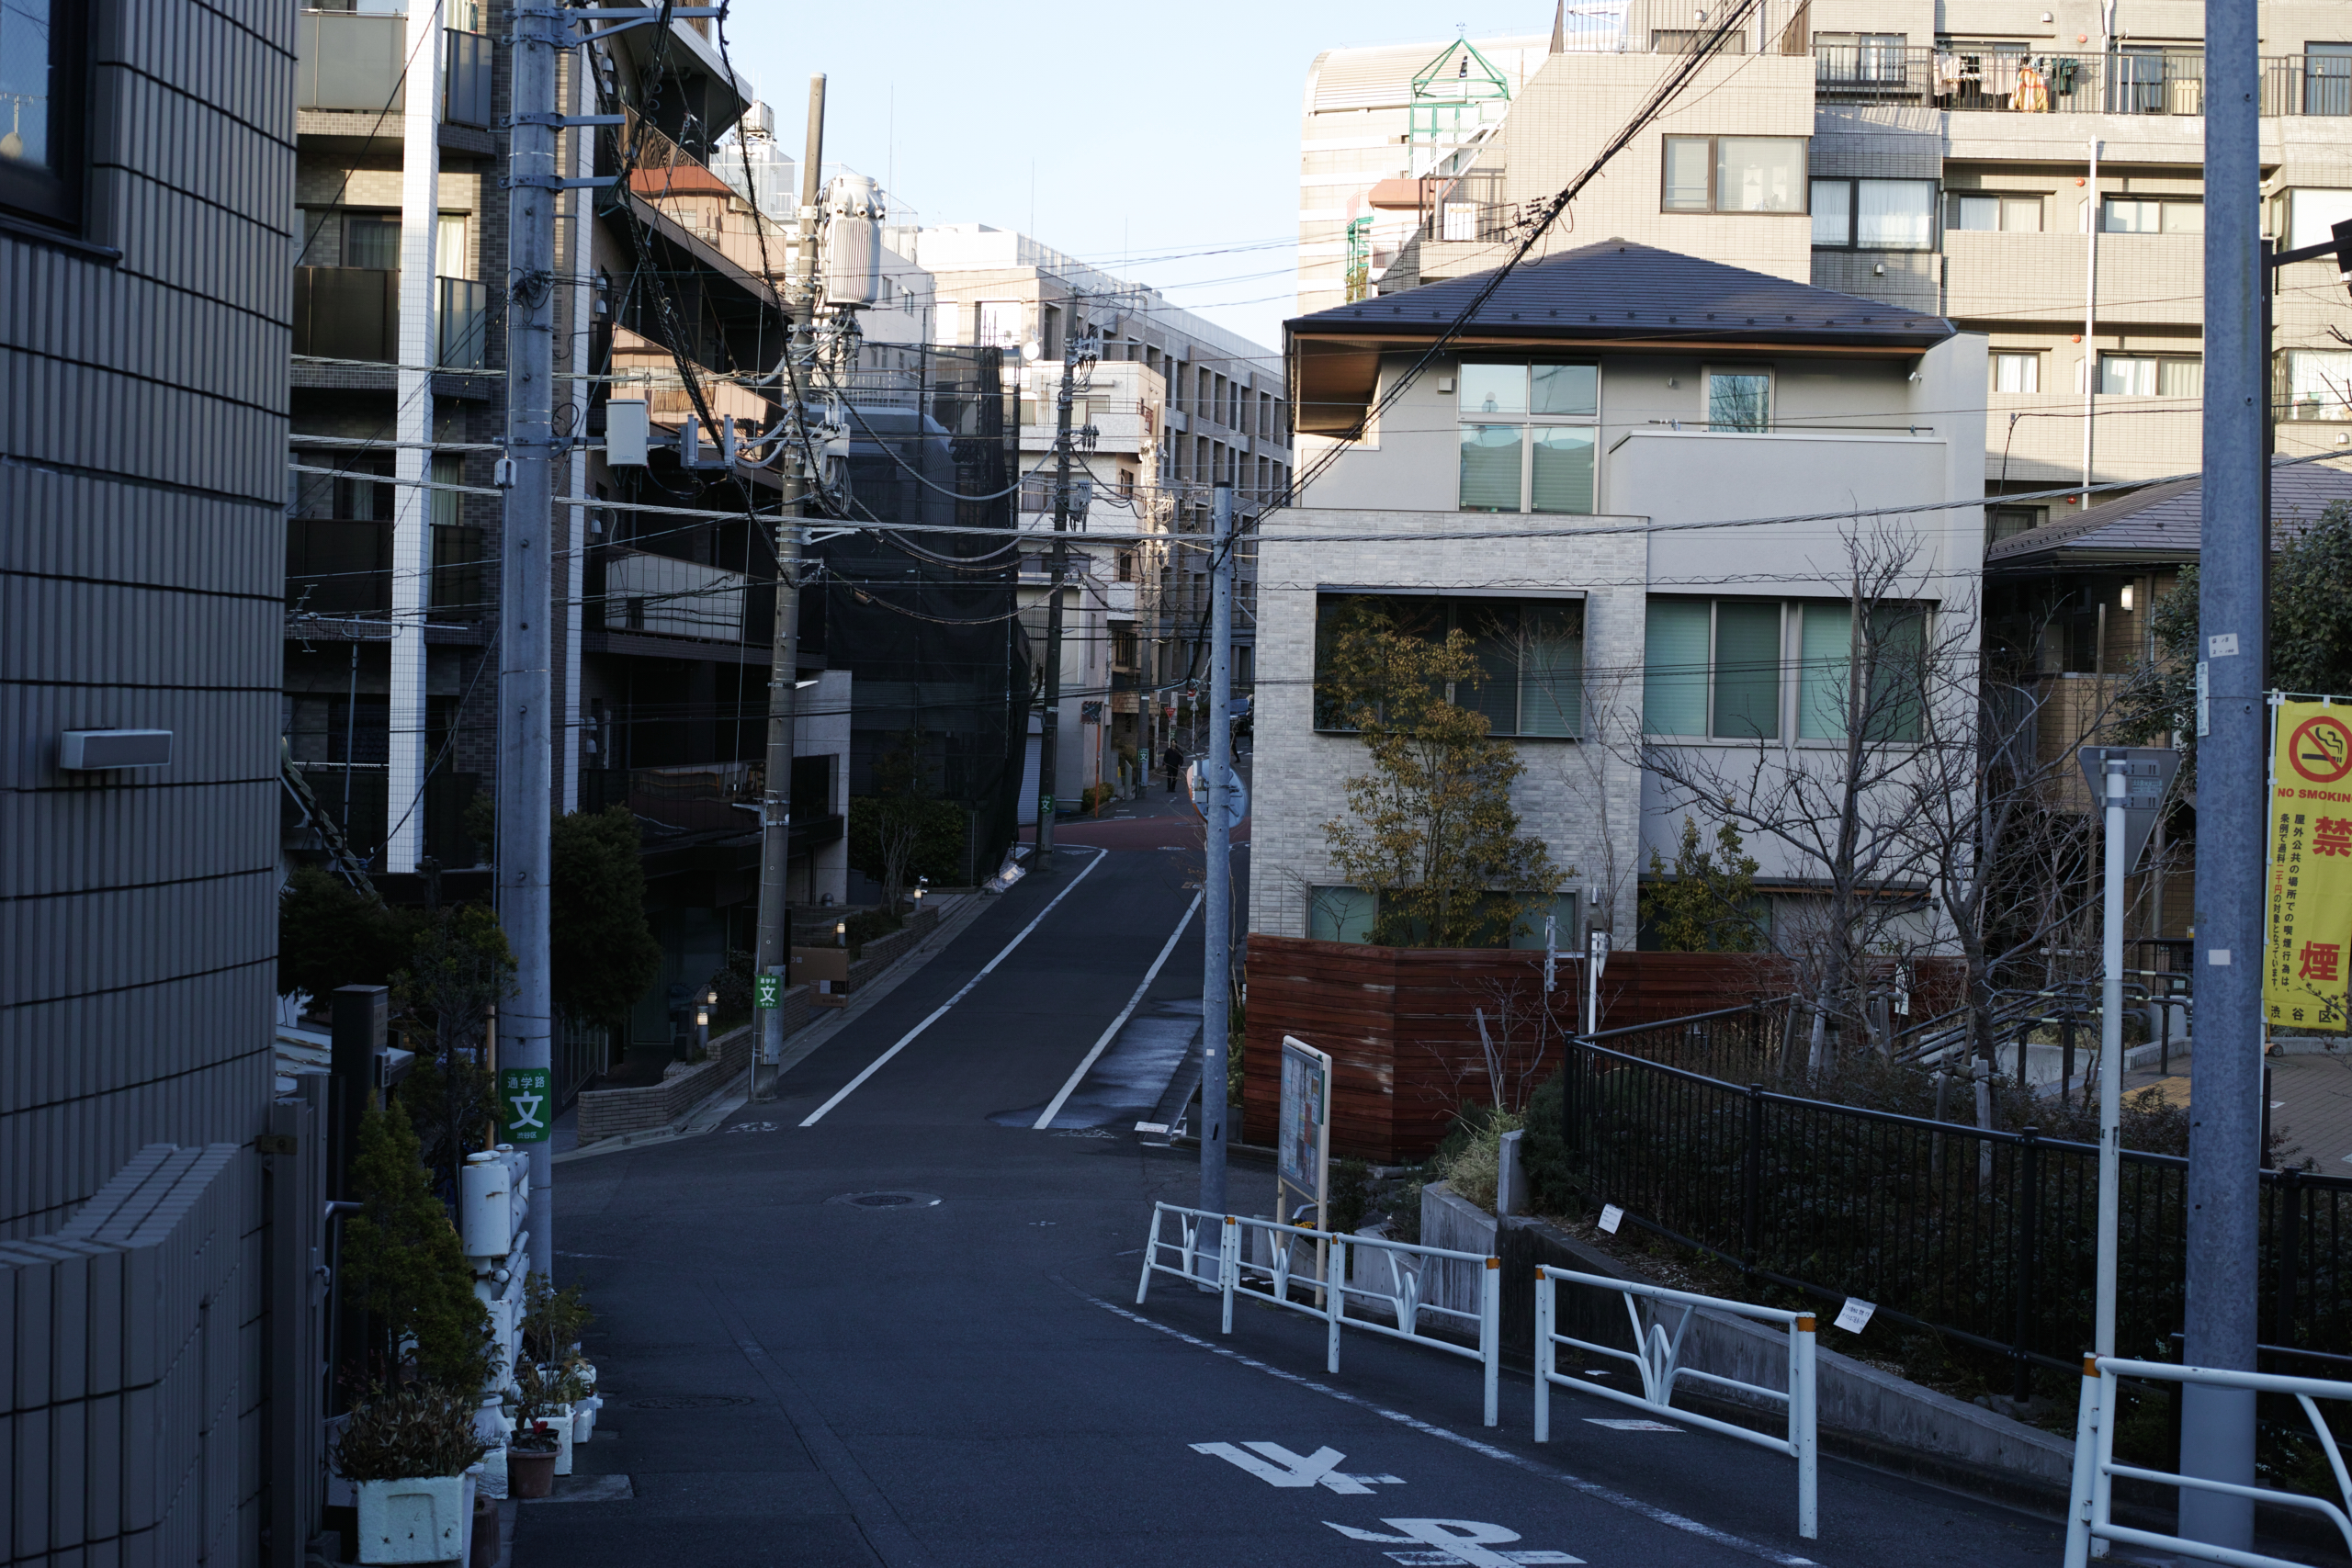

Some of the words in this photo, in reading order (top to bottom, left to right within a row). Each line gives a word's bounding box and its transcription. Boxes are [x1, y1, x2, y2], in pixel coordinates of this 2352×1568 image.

[2278, 787, 2295, 797] NO
[2298, 789, 2352, 803] SMOKIN
[2271, 813, 2290, 992] 条例で過料二千円の対象となっています。
[2282, 814, 2305, 992] 屋外公共の場所での喫煙行為は、
[760, 986, 775, 1002] 文
[507, 1076, 545, 1089] 通学路
[509, 1090, 544, 1130] 文
[516, 1131, 537, 1139] 渋谷区
